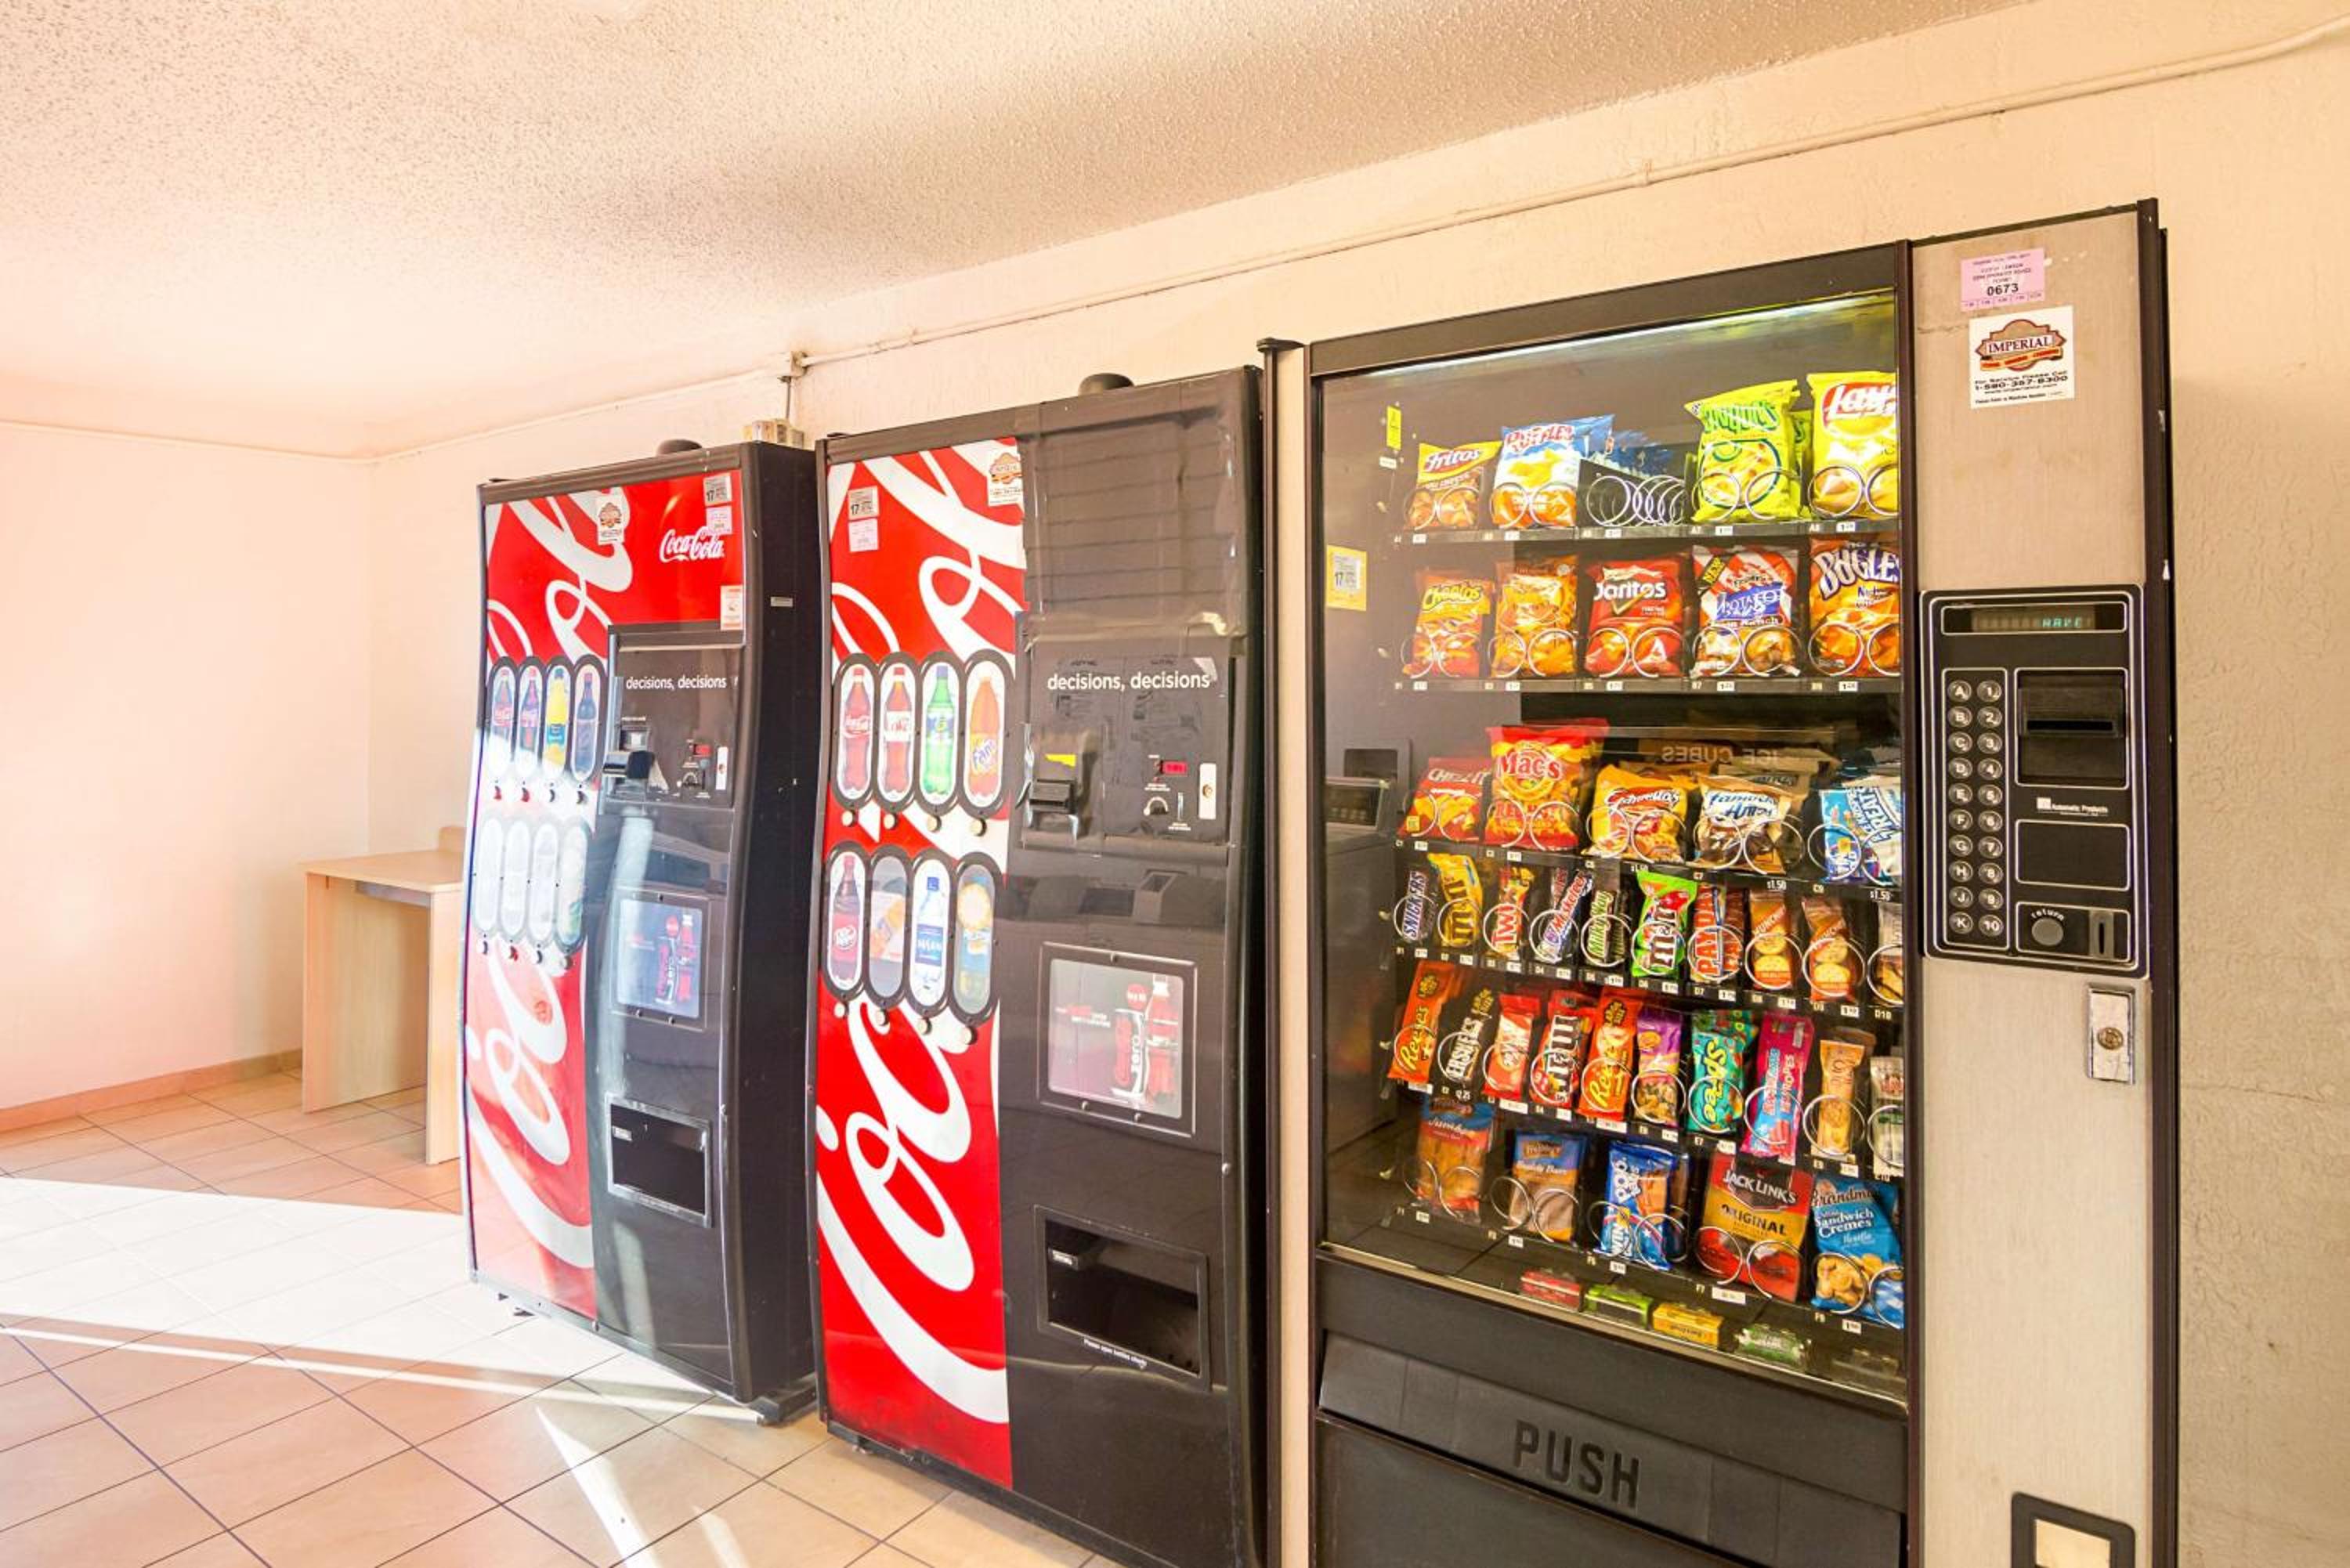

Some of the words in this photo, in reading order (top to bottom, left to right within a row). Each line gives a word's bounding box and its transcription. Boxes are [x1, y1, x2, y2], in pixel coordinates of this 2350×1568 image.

[1987, 283, 2019, 296] 0673
[1988, 336, 2049, 353] IMPERIAL
[1426, 450, 1480, 472] Fritos
[660, 526, 725, 563] Coca-Cola
[1812, 547, 1900, 601] BUGLE
[626, 676, 675, 692] decisions,
[678, 674, 727, 689] decisions
[1047, 673, 1126, 692] decisions,
[1130, 670, 1210, 689] decisions
[2030, 908, 2065, 921] return
[1723, 1169, 1755, 1191] JACK
[1722, 1204, 1787, 1236] ORIGINAL
[1814, 1208, 1875, 1228] Sandwich
[1818, 1219, 1872, 1238] Cremes
[1513, 1418, 1640, 1511] PUSH
